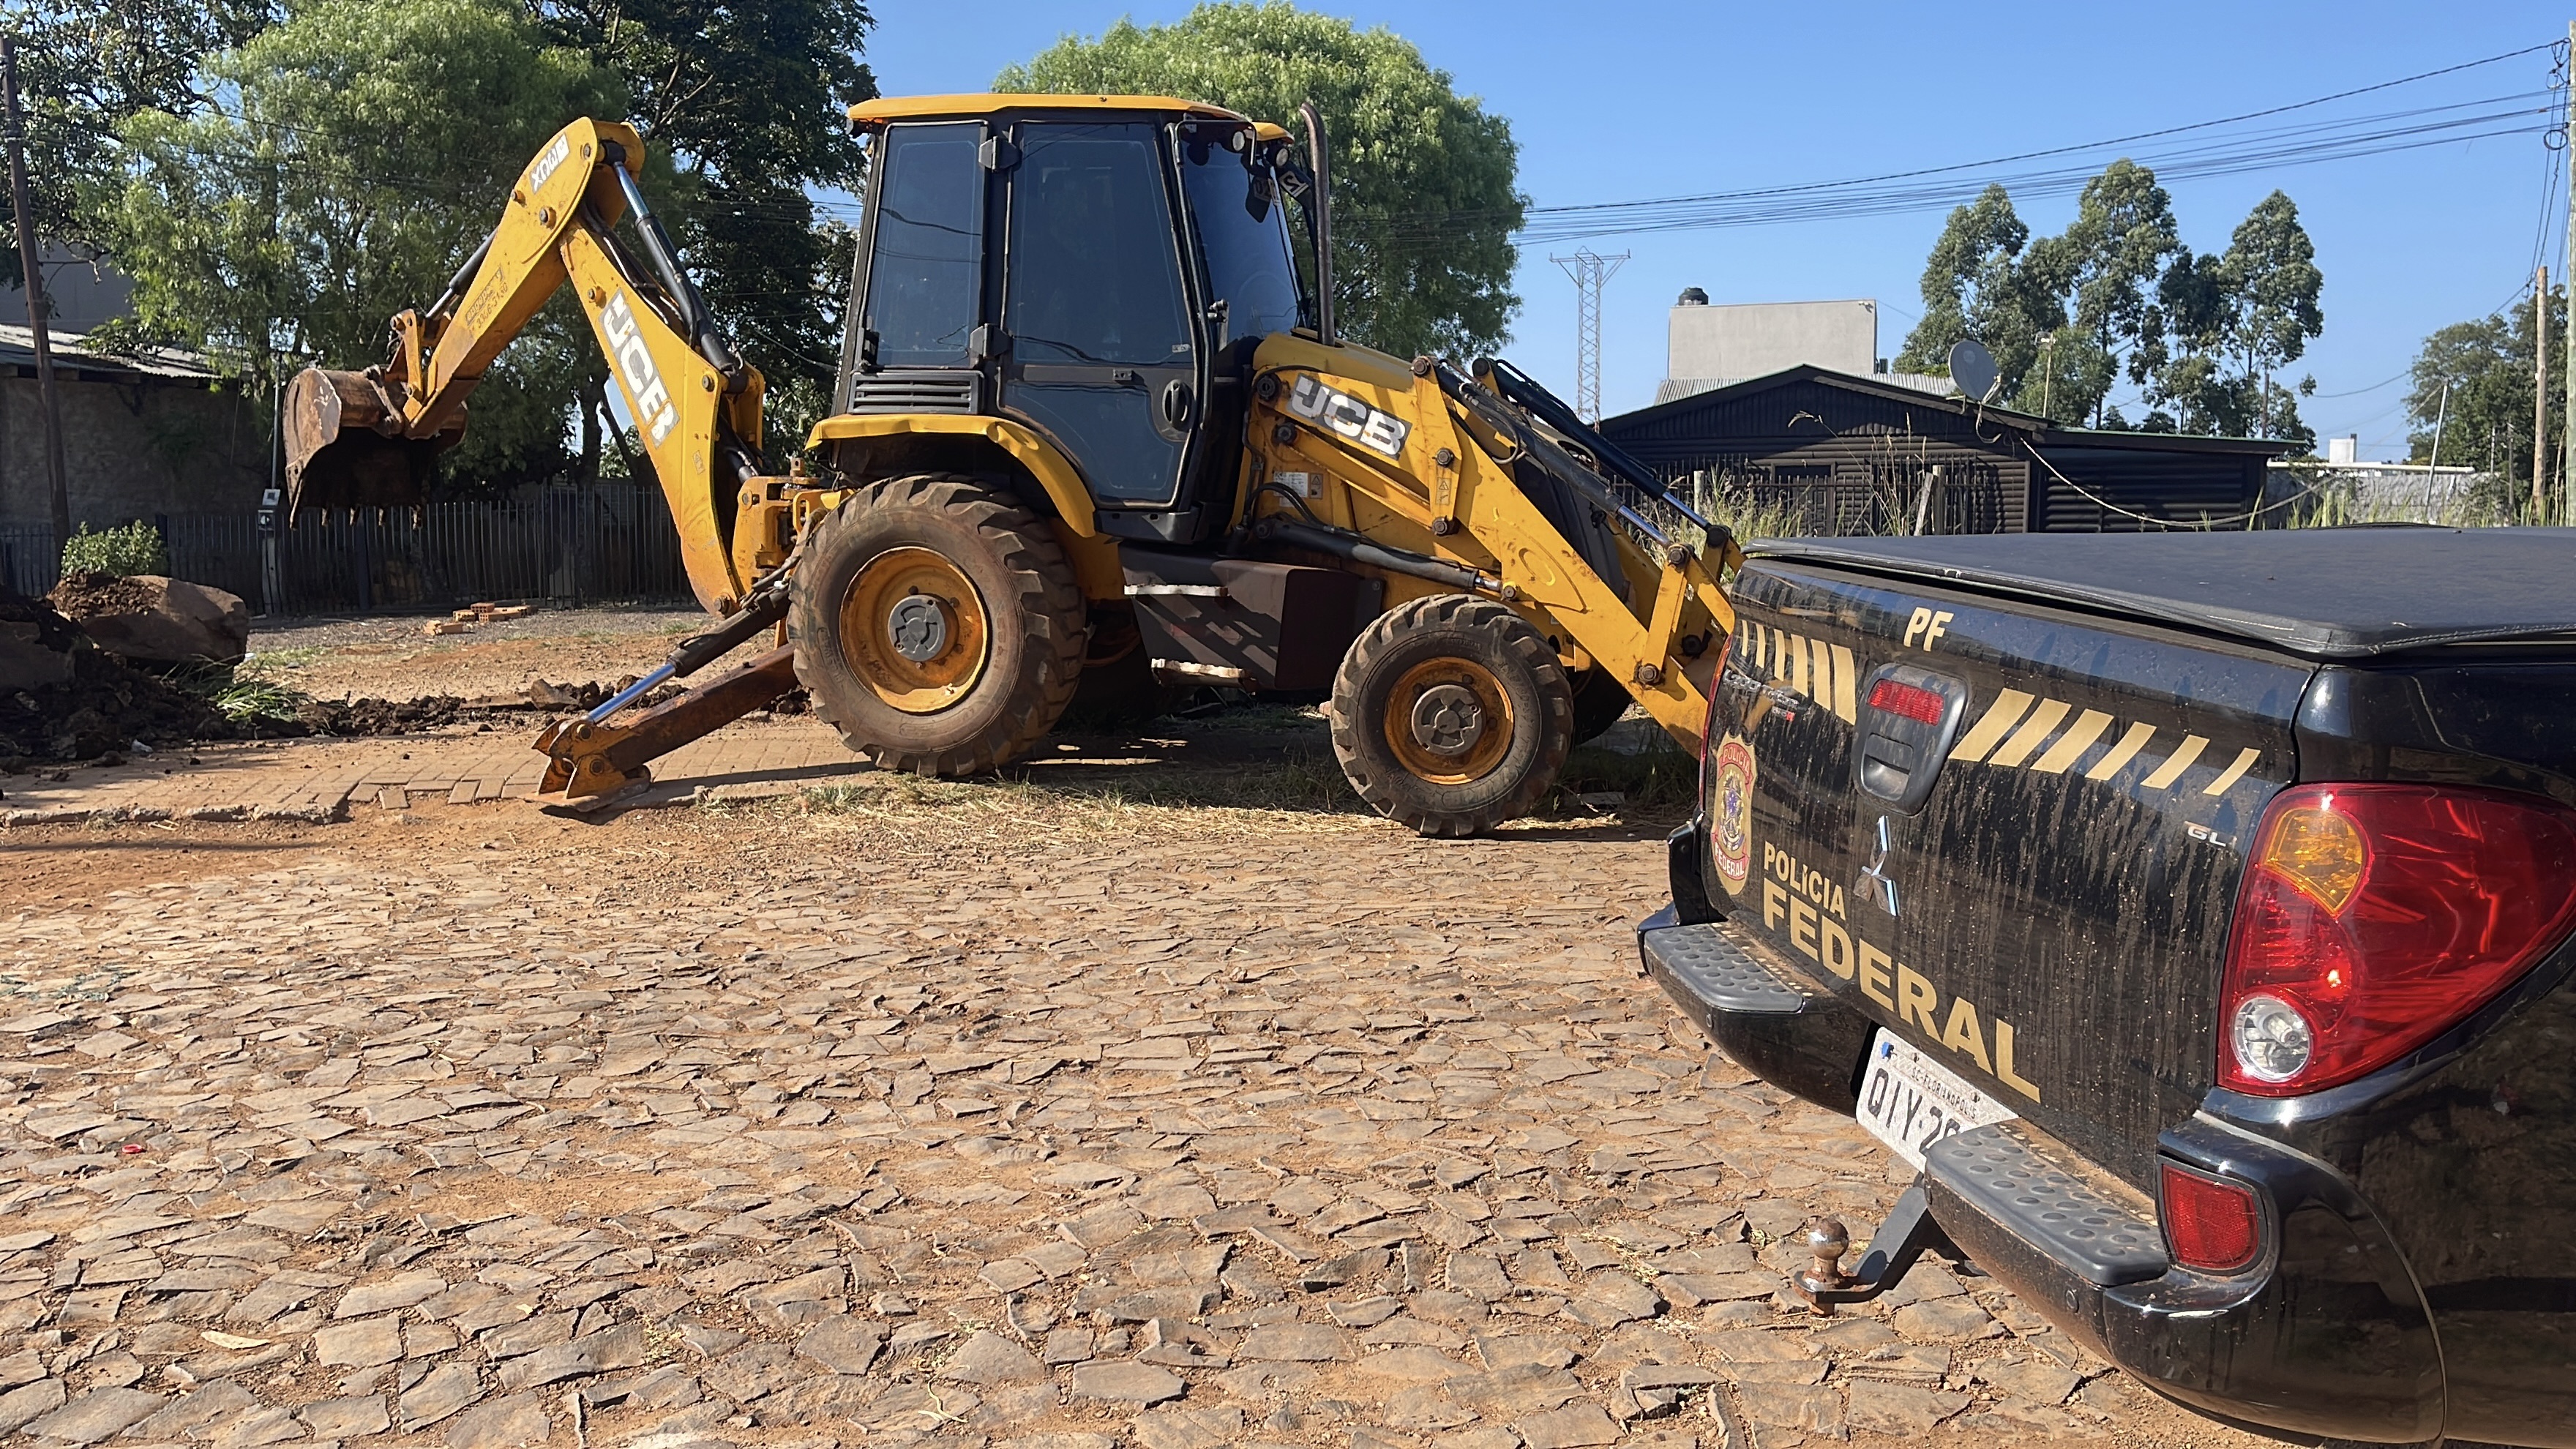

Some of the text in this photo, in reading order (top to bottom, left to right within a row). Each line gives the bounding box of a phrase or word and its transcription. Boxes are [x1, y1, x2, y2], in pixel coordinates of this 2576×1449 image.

[603, 293, 675, 441] JCB
[1291, 375, 1406, 455] JCB
[1903, 607, 1954, 651] PF
[1715, 842, 1745, 877] FEDERAL
[1764, 841, 1846, 921] POLÍCIA
[1764, 877, 2041, 1104] FEDERAL
